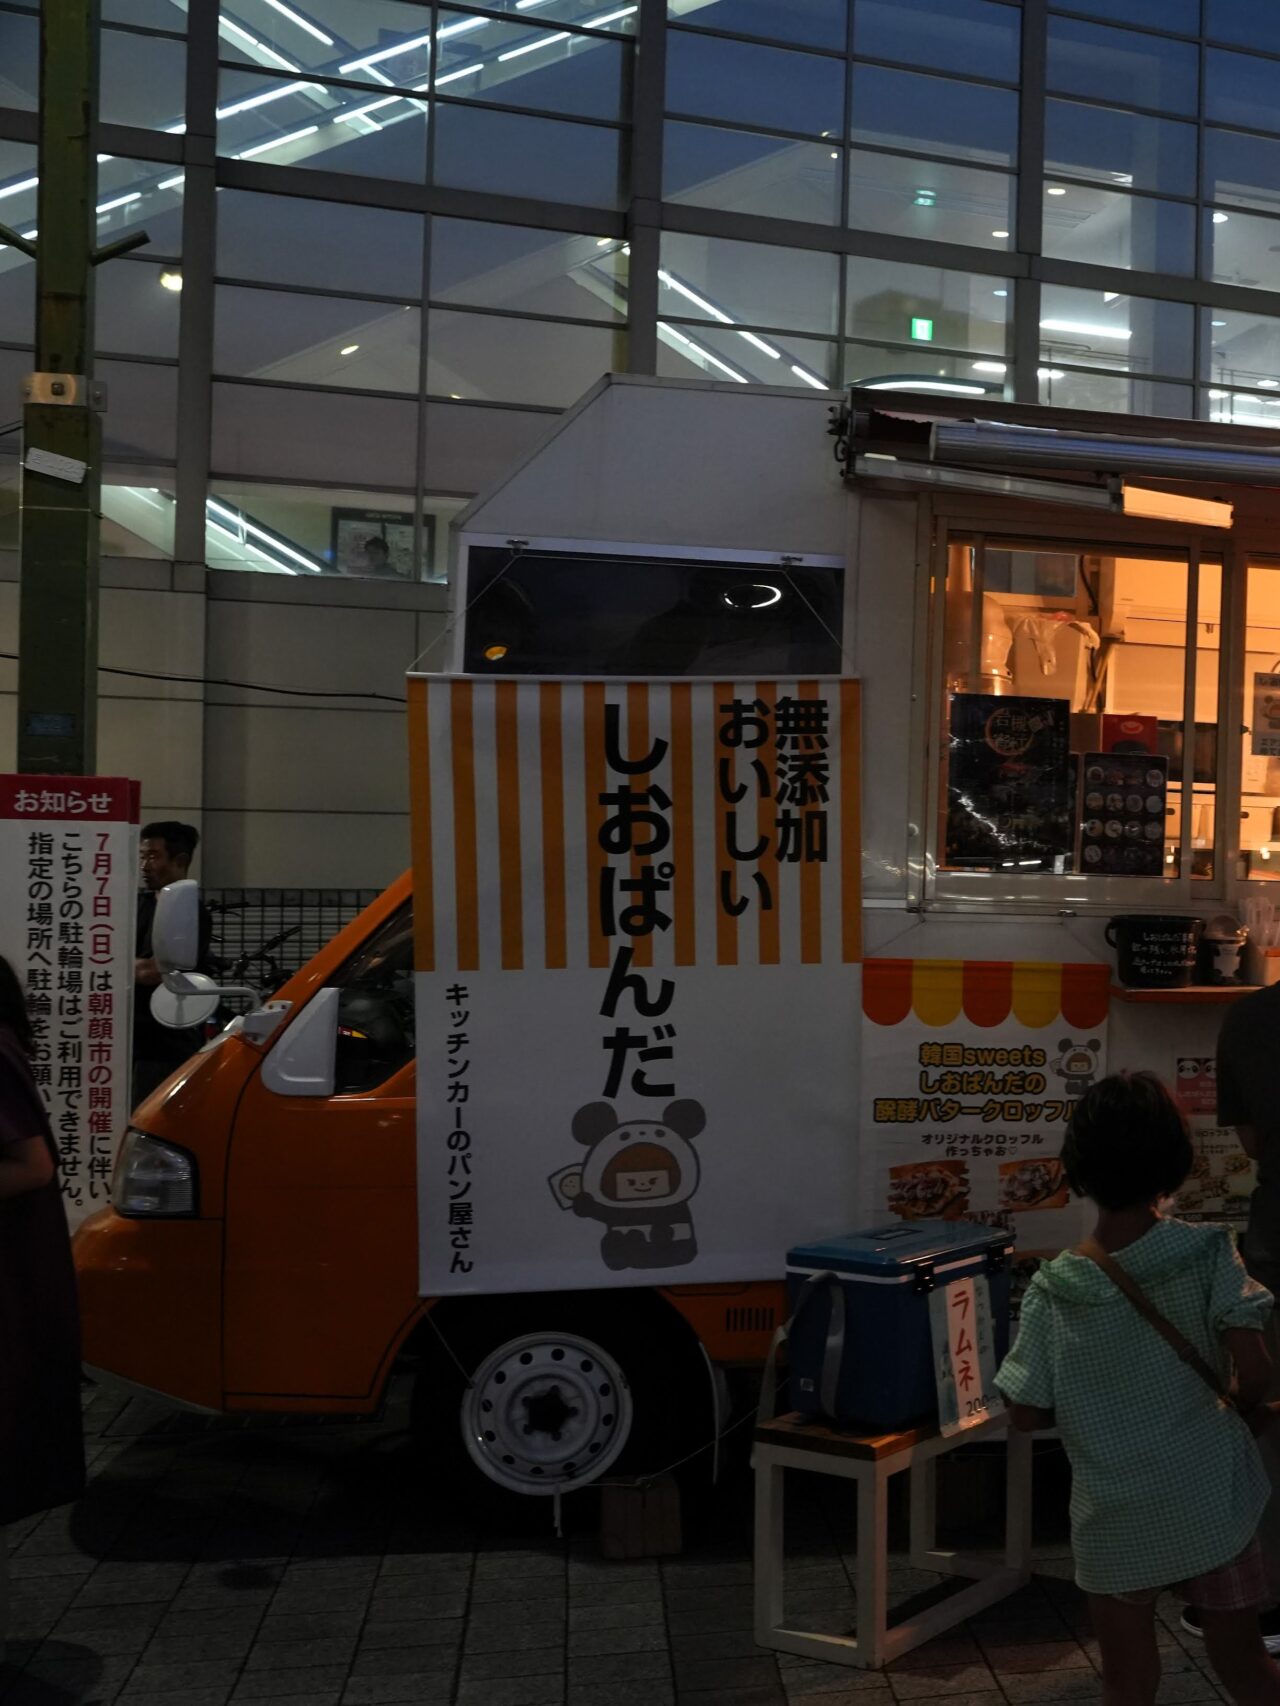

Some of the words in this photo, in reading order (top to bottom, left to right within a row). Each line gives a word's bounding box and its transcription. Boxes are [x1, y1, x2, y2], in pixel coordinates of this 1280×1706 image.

[13, 789, 113, 814] お知らせ
[717, 697, 774, 917] おいしい
[774, 695, 830, 863] 無添加
[597, 703, 677, 1099] しおぱんだ
[57, 832, 84, 1207] こちらの駐輪場はご利用できません。
[445, 983, 474, 1274] キッチンカーのパン屋さん
[921, 1133, 1044, 1145] オリジナルクロッフル
[951, 1290, 975, 1392] ラムネ
